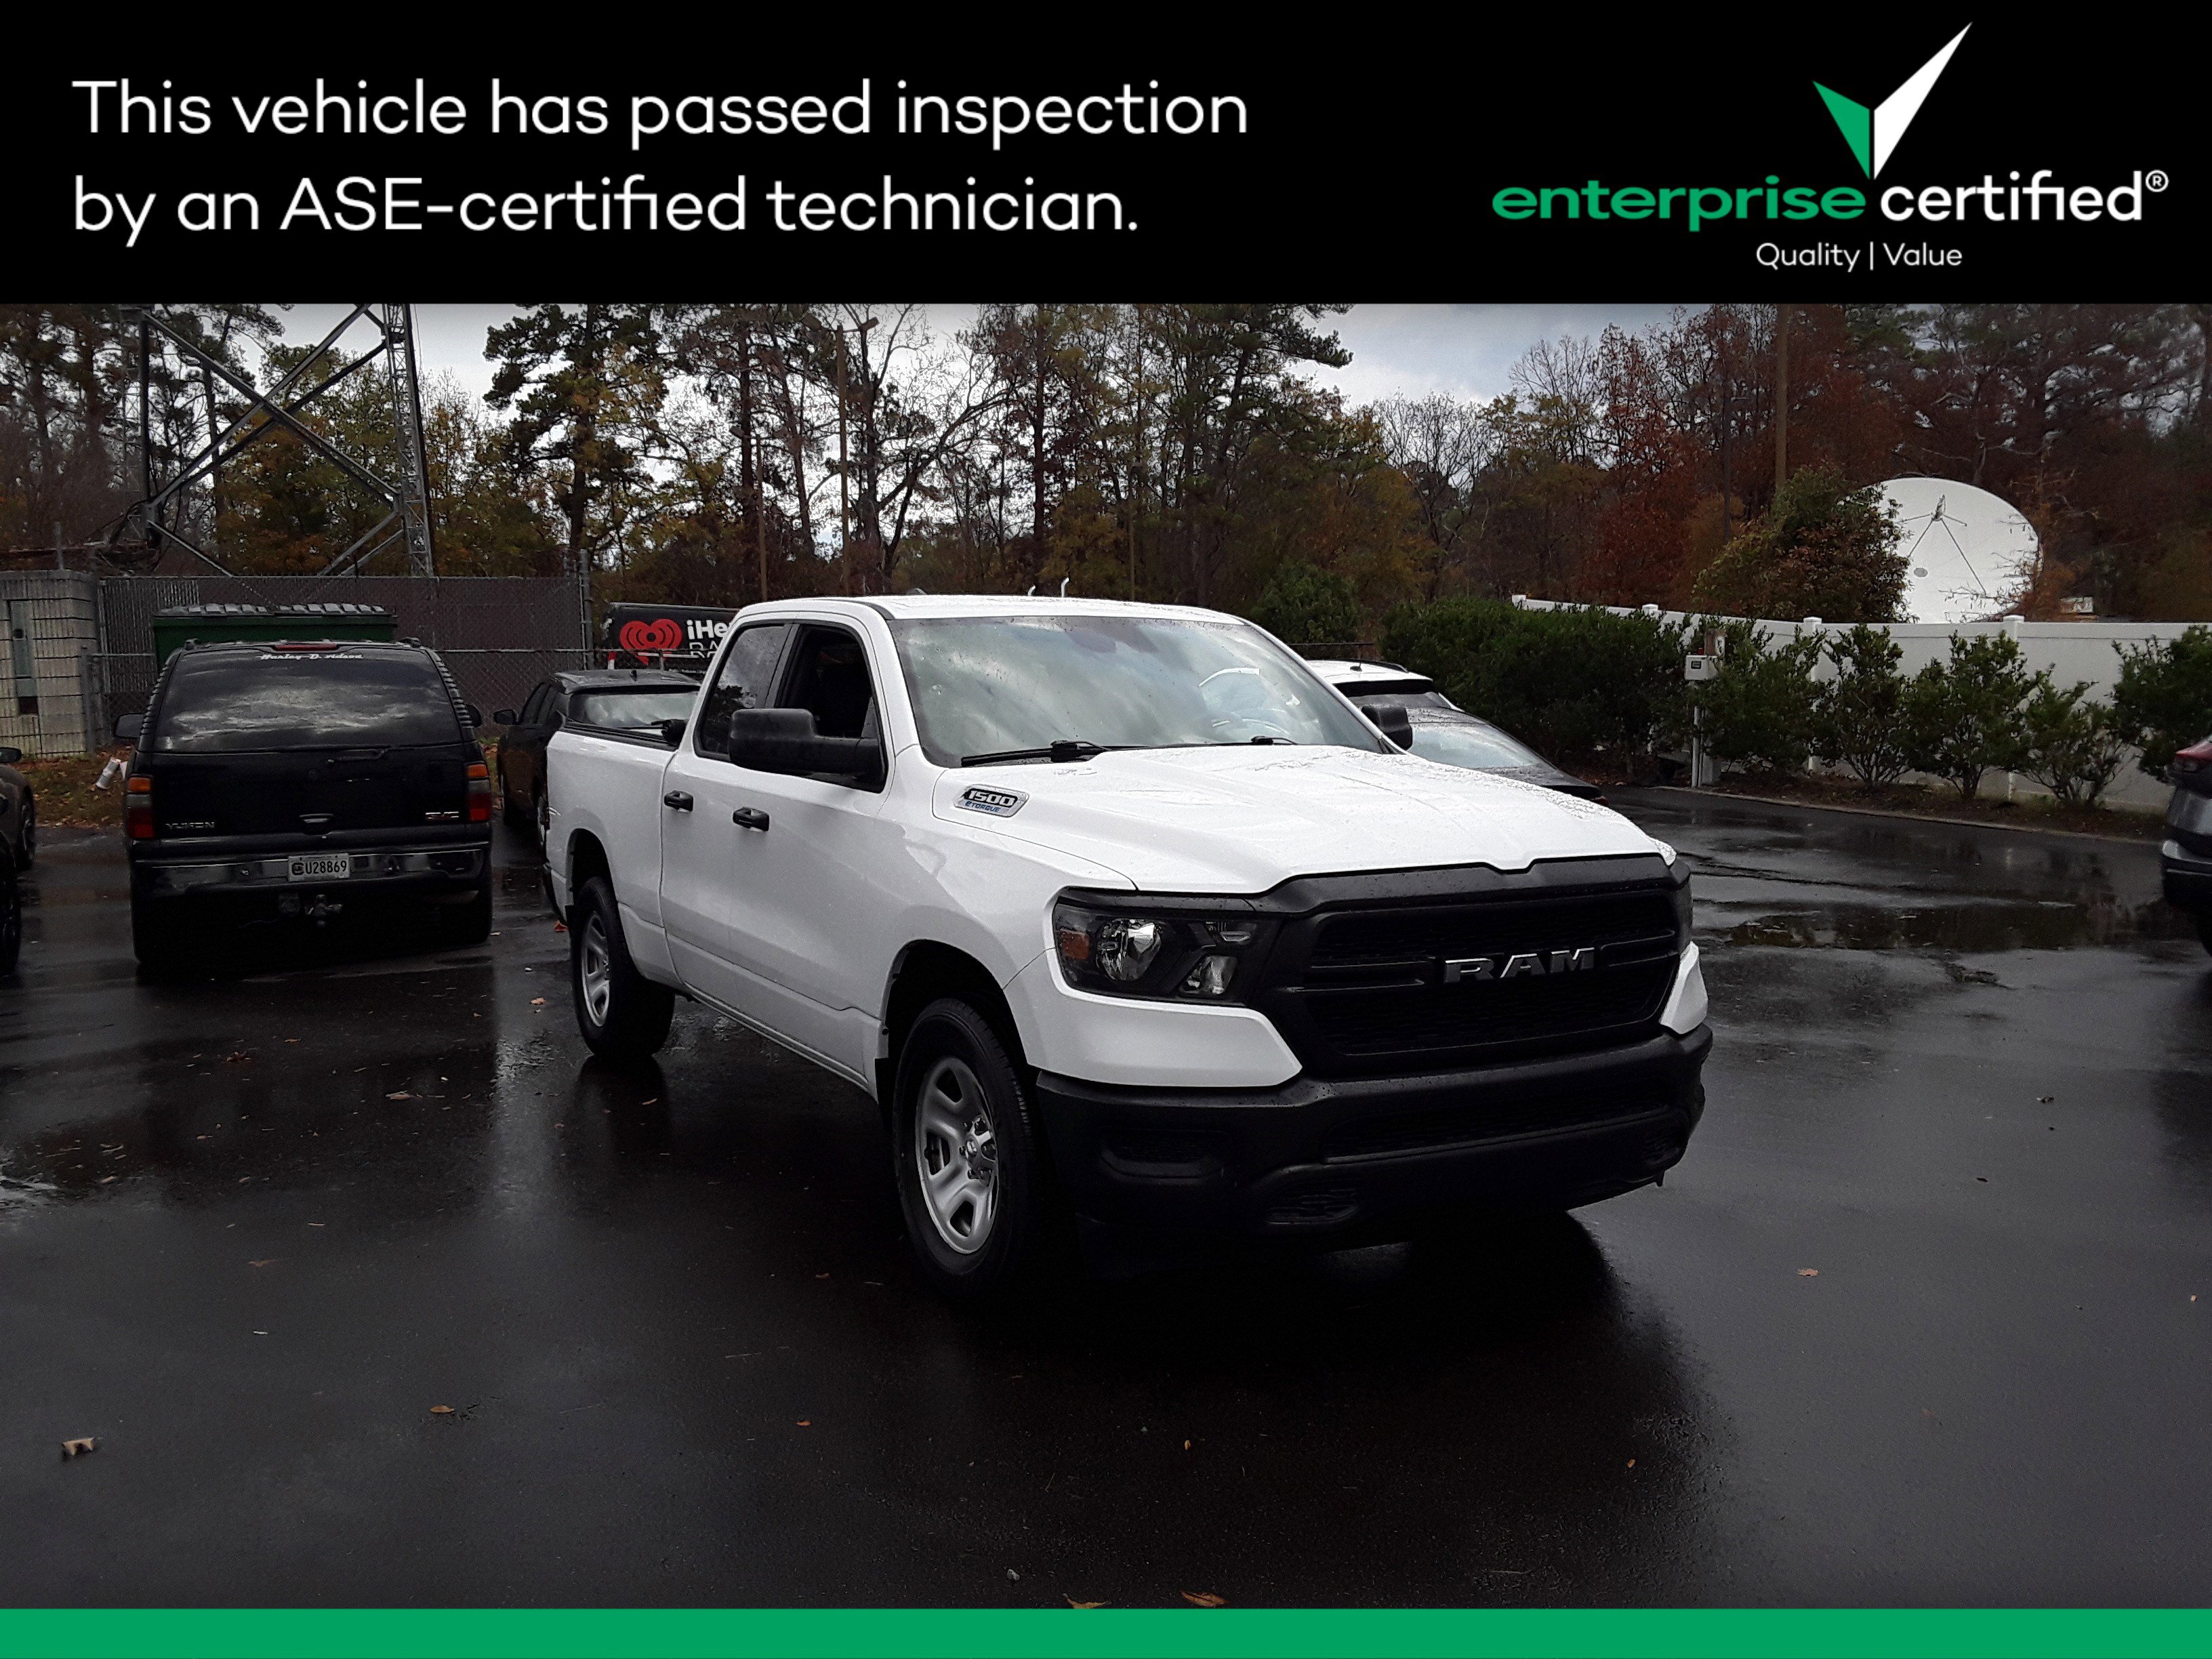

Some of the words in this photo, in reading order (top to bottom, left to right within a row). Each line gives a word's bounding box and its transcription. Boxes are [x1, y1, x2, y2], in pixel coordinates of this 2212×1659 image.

[968, 790, 1016, 806] 1500
[305, 860, 347, 874] U28869
[1443, 947, 1595, 983] RAM
